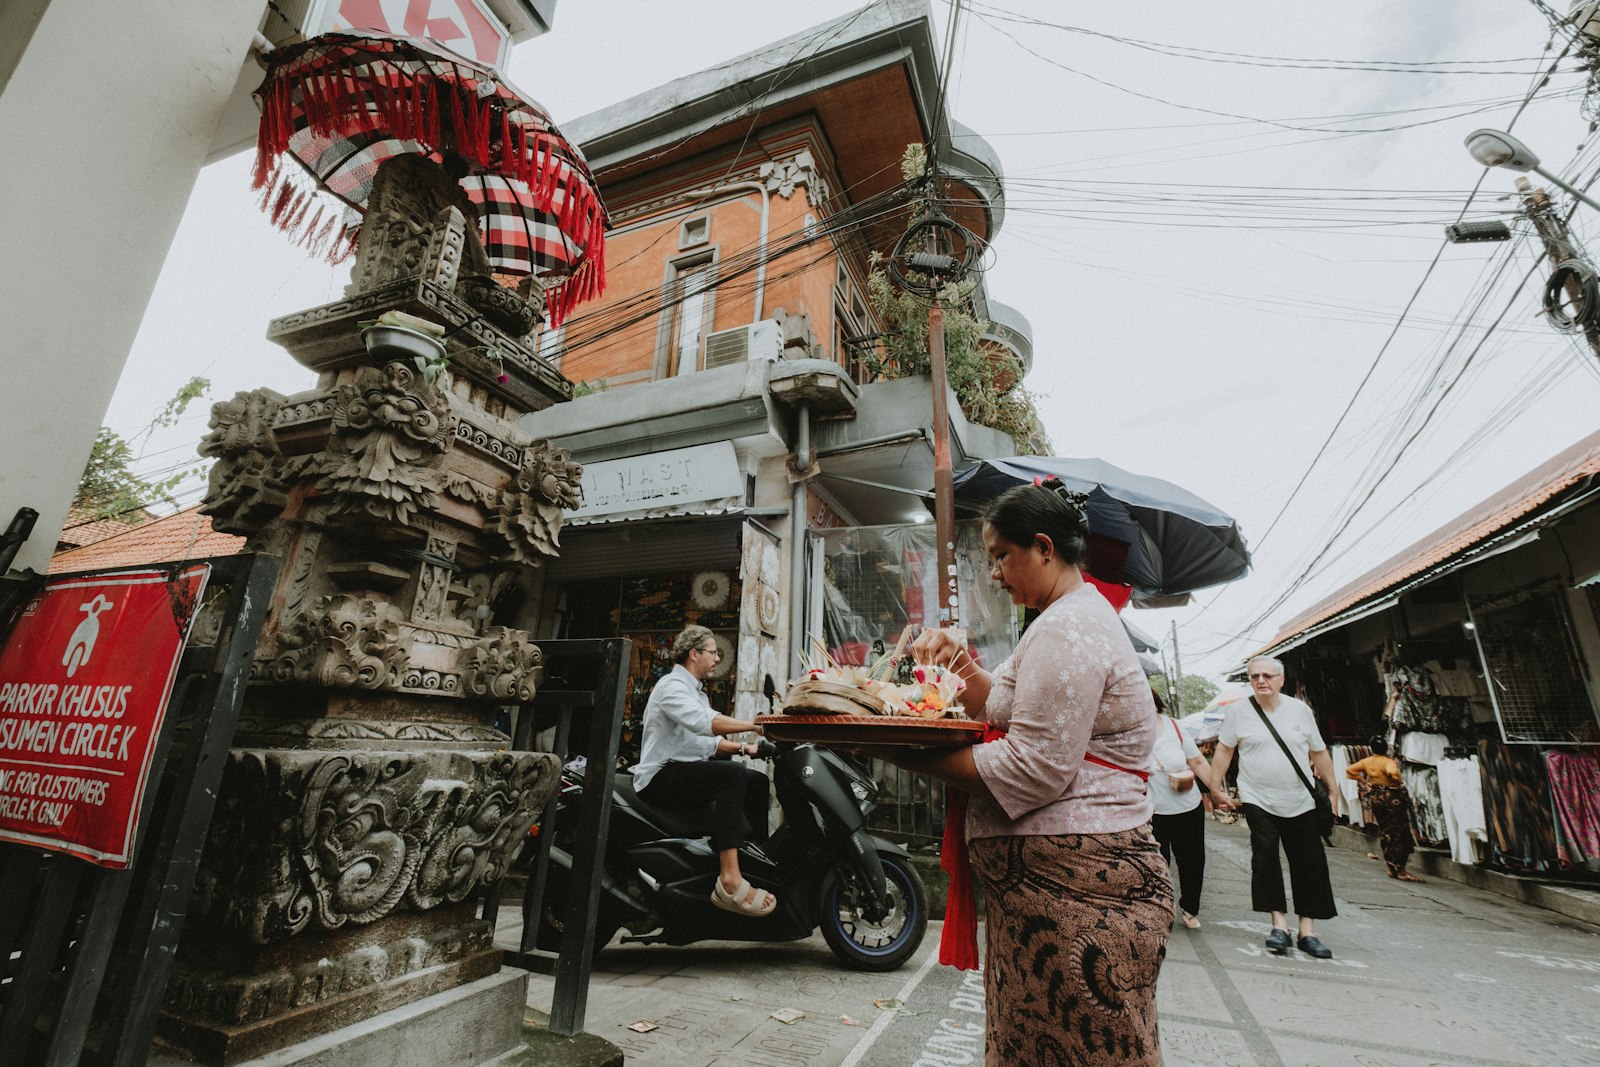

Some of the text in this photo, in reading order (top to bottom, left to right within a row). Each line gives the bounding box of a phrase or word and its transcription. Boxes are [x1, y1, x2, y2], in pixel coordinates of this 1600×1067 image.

[0, 682, 132, 718] PARKIR KHUSUS
[0, 718, 137, 761] SUMEN CIRCLE K
[13, 771, 40, 796] FOR
[38, 774, 110, 806] CUSTOMERS
[27, 798, 40, 822] K
[37, 801, 73, 826] ONLY
